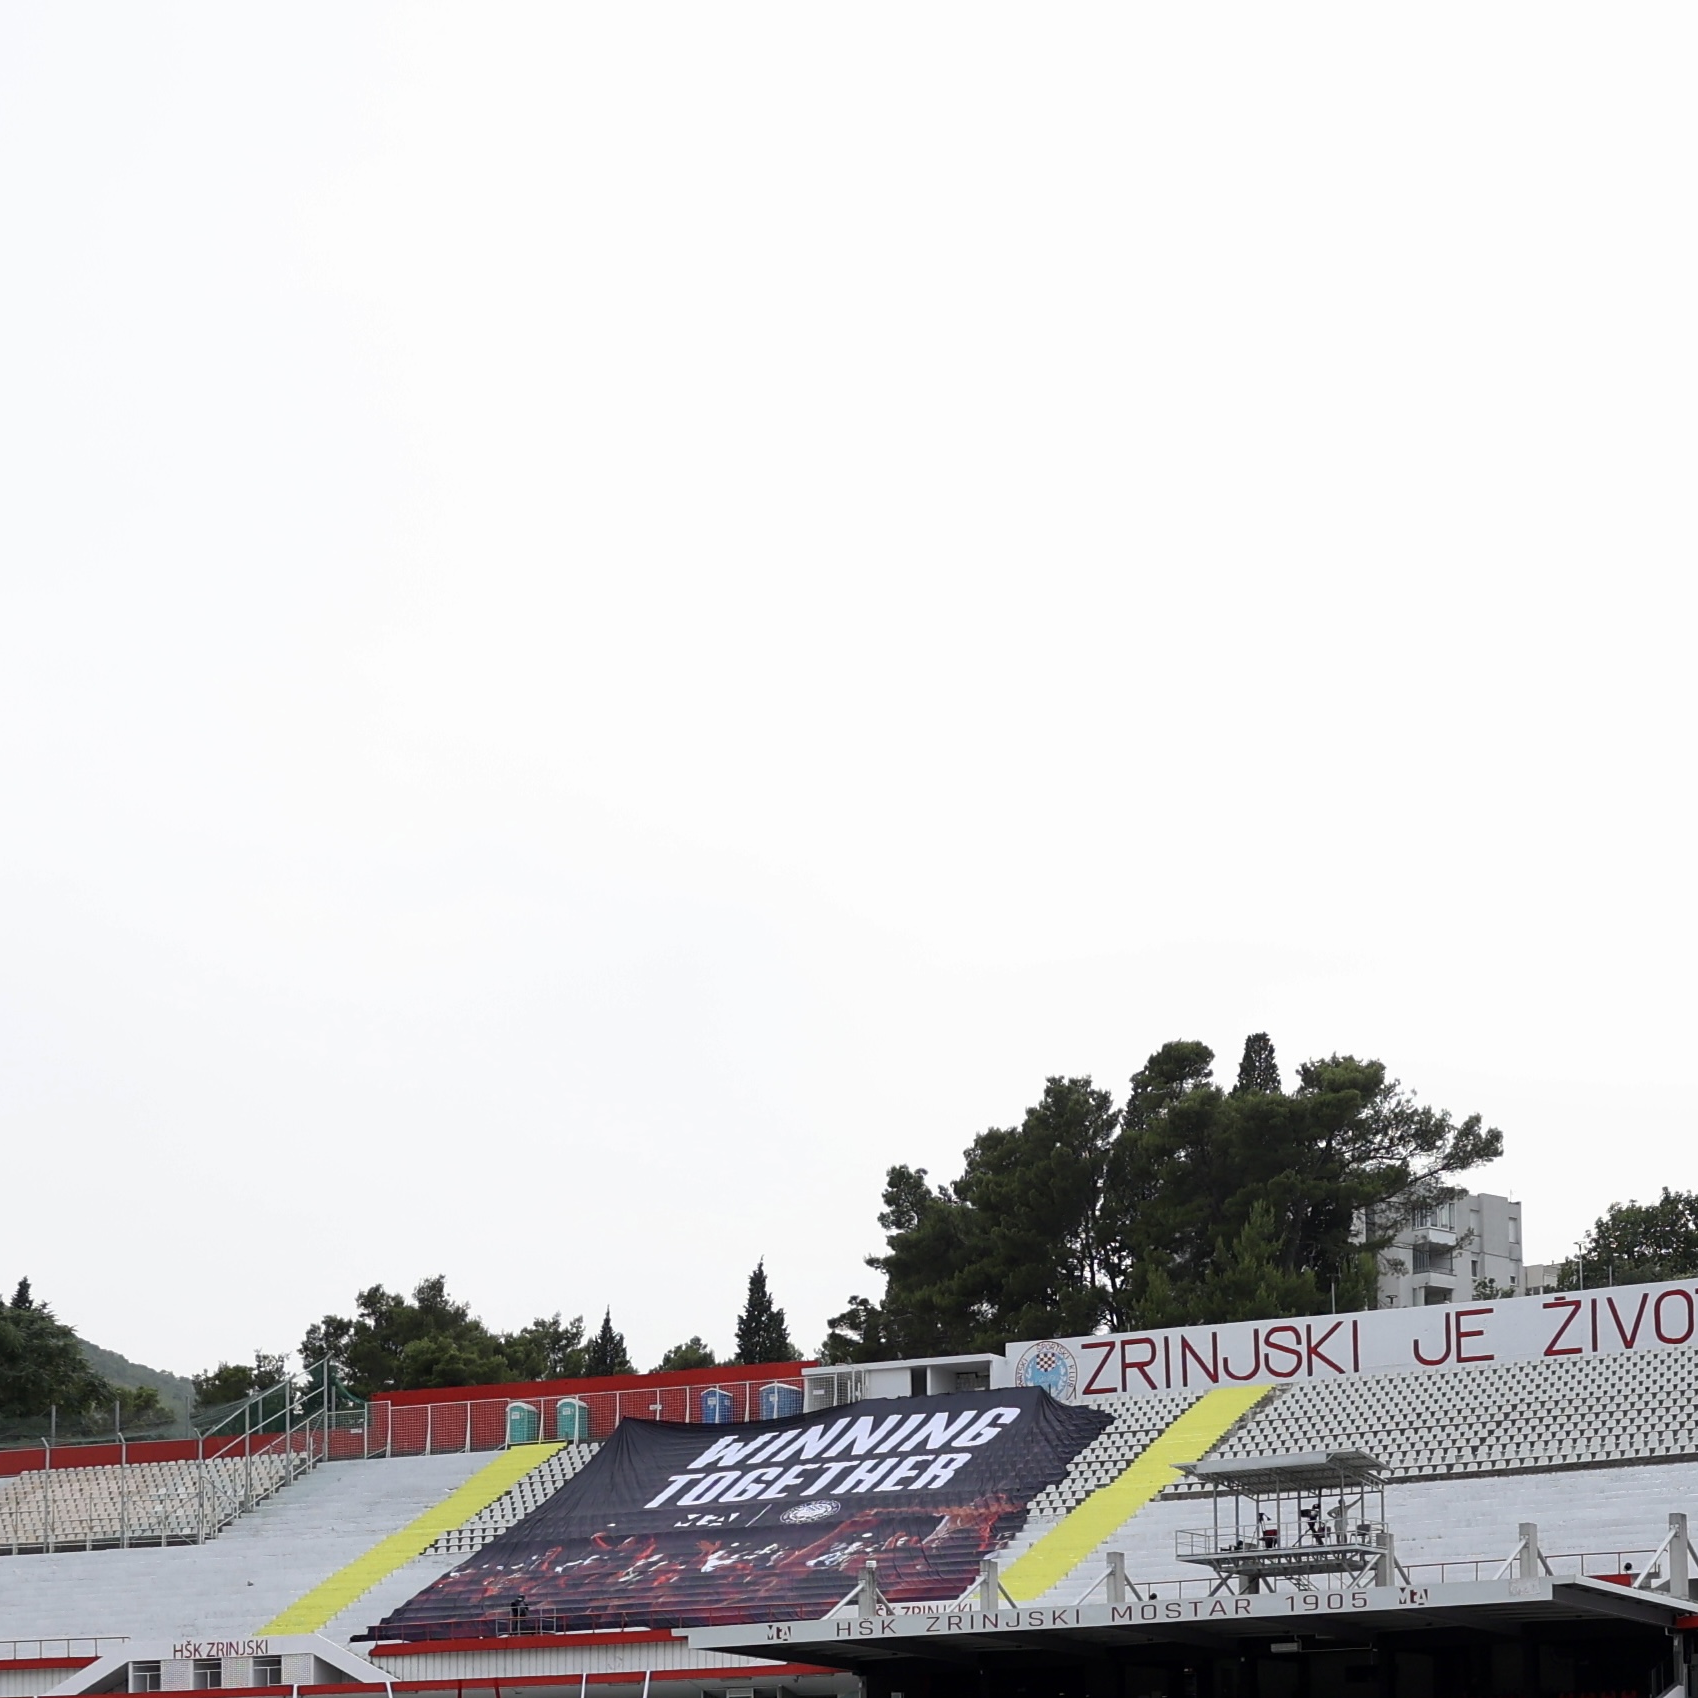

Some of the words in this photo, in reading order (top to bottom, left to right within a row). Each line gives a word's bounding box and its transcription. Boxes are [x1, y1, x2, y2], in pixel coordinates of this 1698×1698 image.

[1081, 1320, 1360, 1395] ZRINJSKI
[1413, 1308, 1494, 1366] JE
[686, 1406, 1021, 1470] WINNING
[644, 1452, 972, 1509] TOGETHER
[836, 1617, 898, 1637] HŠK
[925, 1608, 1080, 1633] ZRINJSKI
[1111, 1598, 1252, 1623] MOSTAR
[1285, 1591, 1368, 1613] 1905
[173, 1640, 203, 1659] HŠK
[206, 1639, 268, 1657] ZRINJSKI
